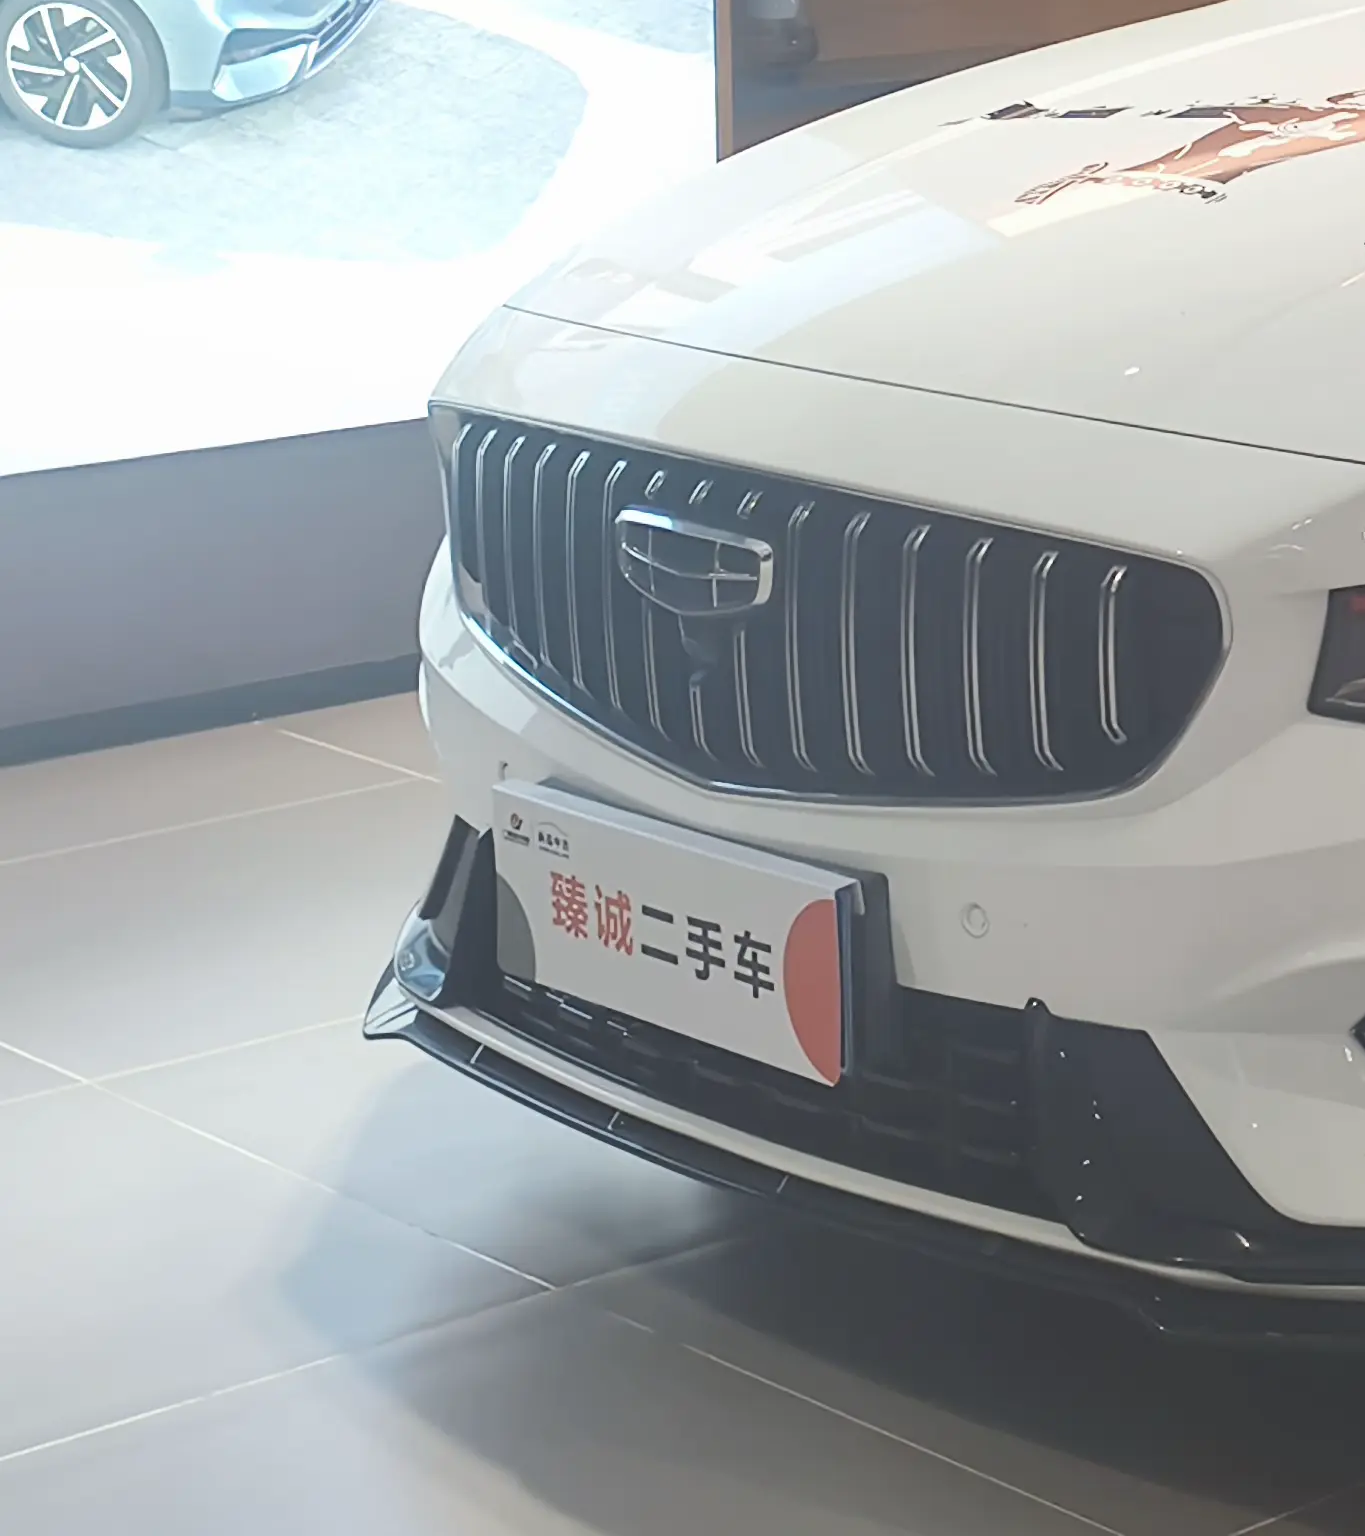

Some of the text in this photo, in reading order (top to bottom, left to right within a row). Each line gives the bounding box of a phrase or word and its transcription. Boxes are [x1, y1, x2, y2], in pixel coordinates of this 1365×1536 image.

[549, 870, 776, 1000] 臻诚二手车
